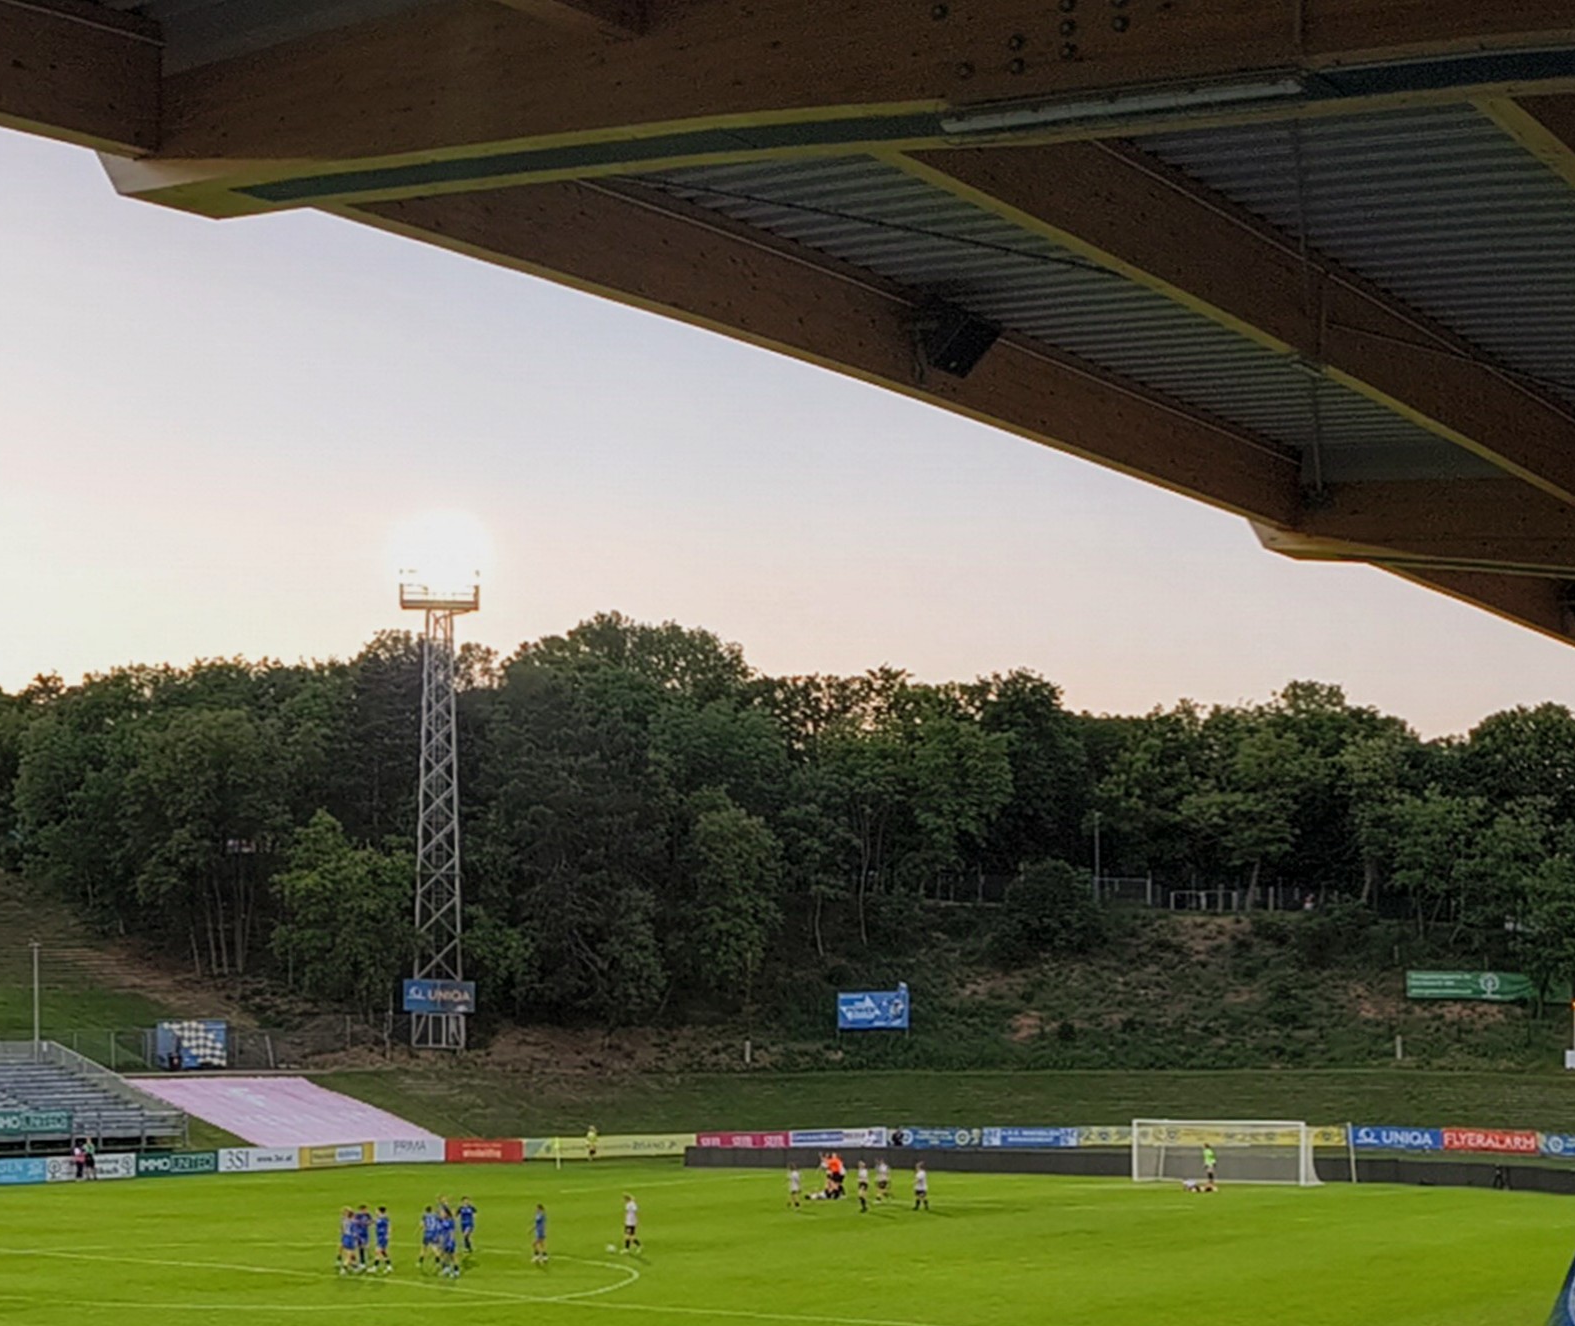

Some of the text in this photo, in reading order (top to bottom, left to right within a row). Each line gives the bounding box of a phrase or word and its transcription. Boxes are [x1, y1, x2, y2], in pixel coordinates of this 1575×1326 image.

[427, 989, 470, 1001] UNIQA
[1381, 1131, 1433, 1146] UNIQA
[1443, 1131, 1536, 1150] FLYERALARM
[139, 1155, 214, 1171] IMMO UNITED
